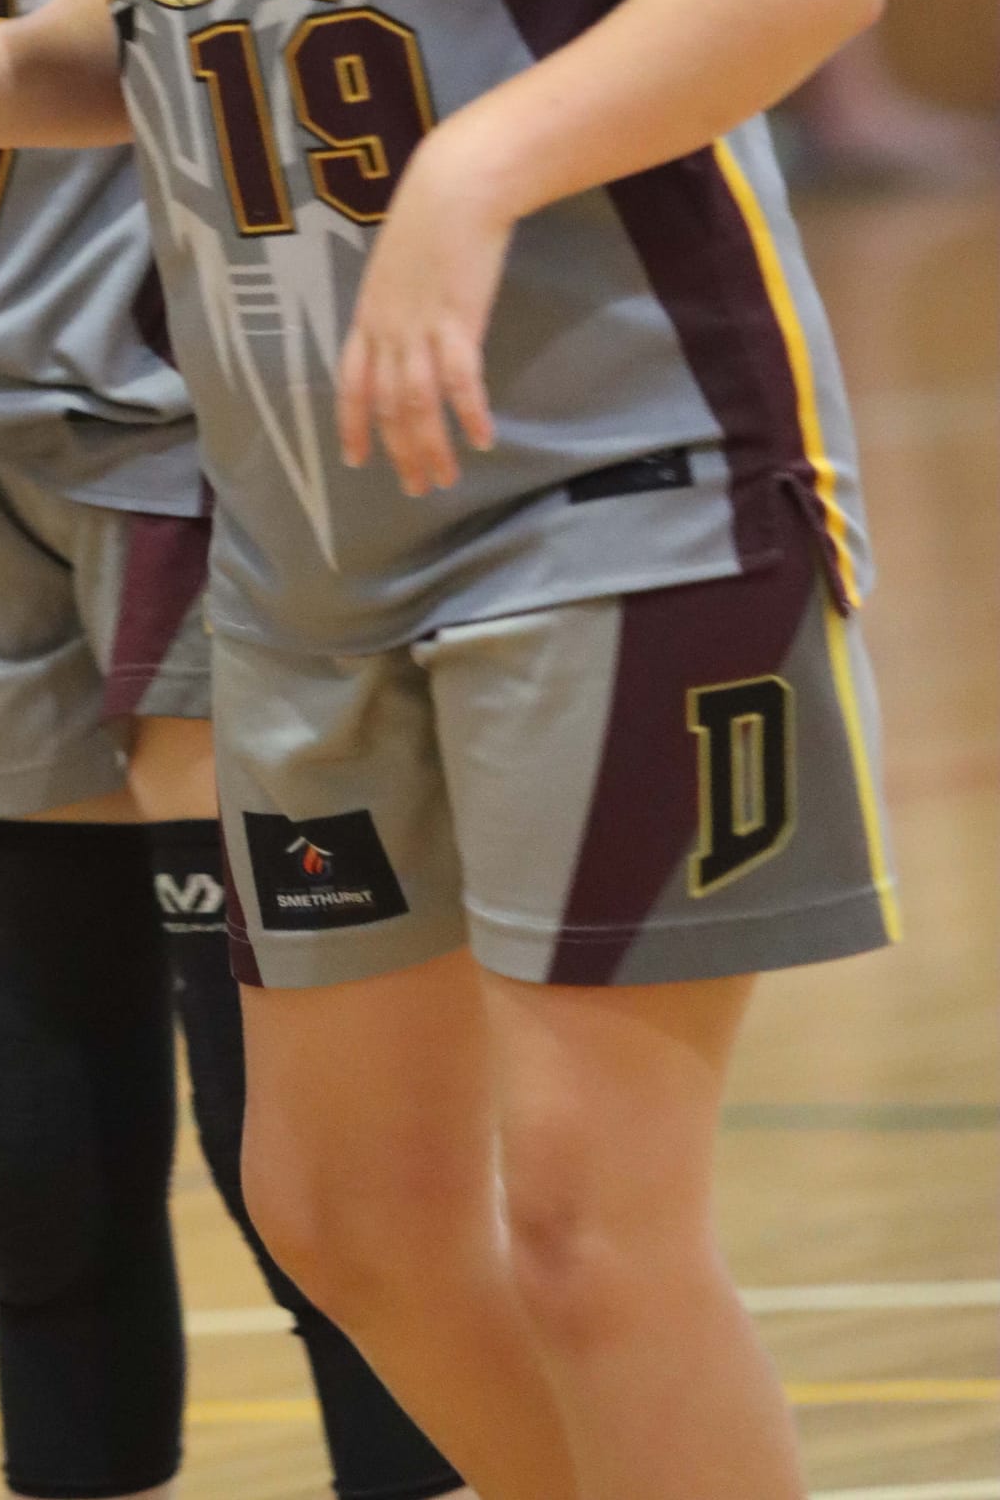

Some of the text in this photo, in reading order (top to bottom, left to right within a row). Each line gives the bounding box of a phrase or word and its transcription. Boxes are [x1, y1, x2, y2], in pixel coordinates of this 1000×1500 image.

[187, 6, 438, 237] 19
[276, 890, 374, 908] SMETHURST
[686, 673, 794, 899] D
